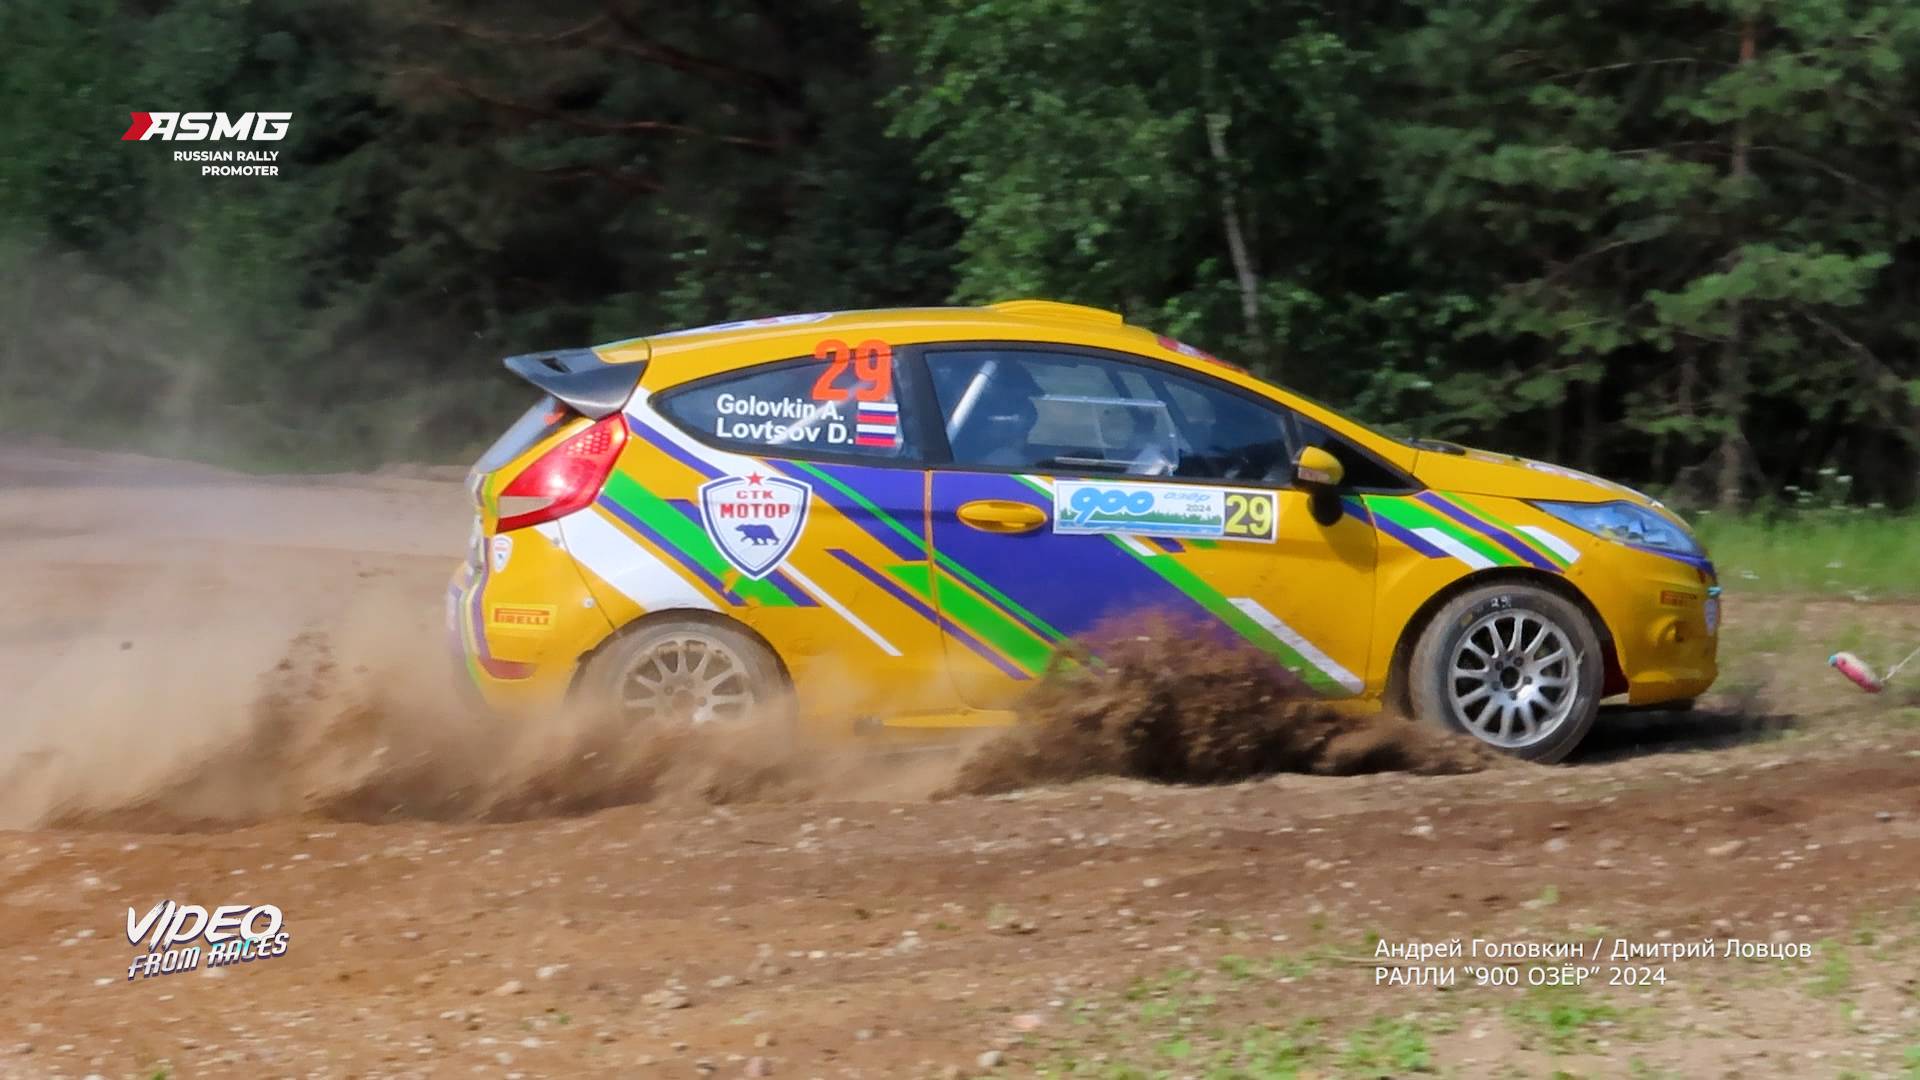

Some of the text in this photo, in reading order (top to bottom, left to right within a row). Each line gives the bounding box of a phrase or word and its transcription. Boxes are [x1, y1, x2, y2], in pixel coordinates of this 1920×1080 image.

[811, 338, 893, 401] 29
[716, 393, 845, 421] Golovkin A.
[715, 417, 855, 445] Lovtsov D.
[736, 490, 774, 500] СТК
[1070, 487, 1155, 526] 900
[720, 503, 791, 519] МОТОР
[1225, 494, 1272, 536] 29
[494, 607, 551, 625] PIRELLI
